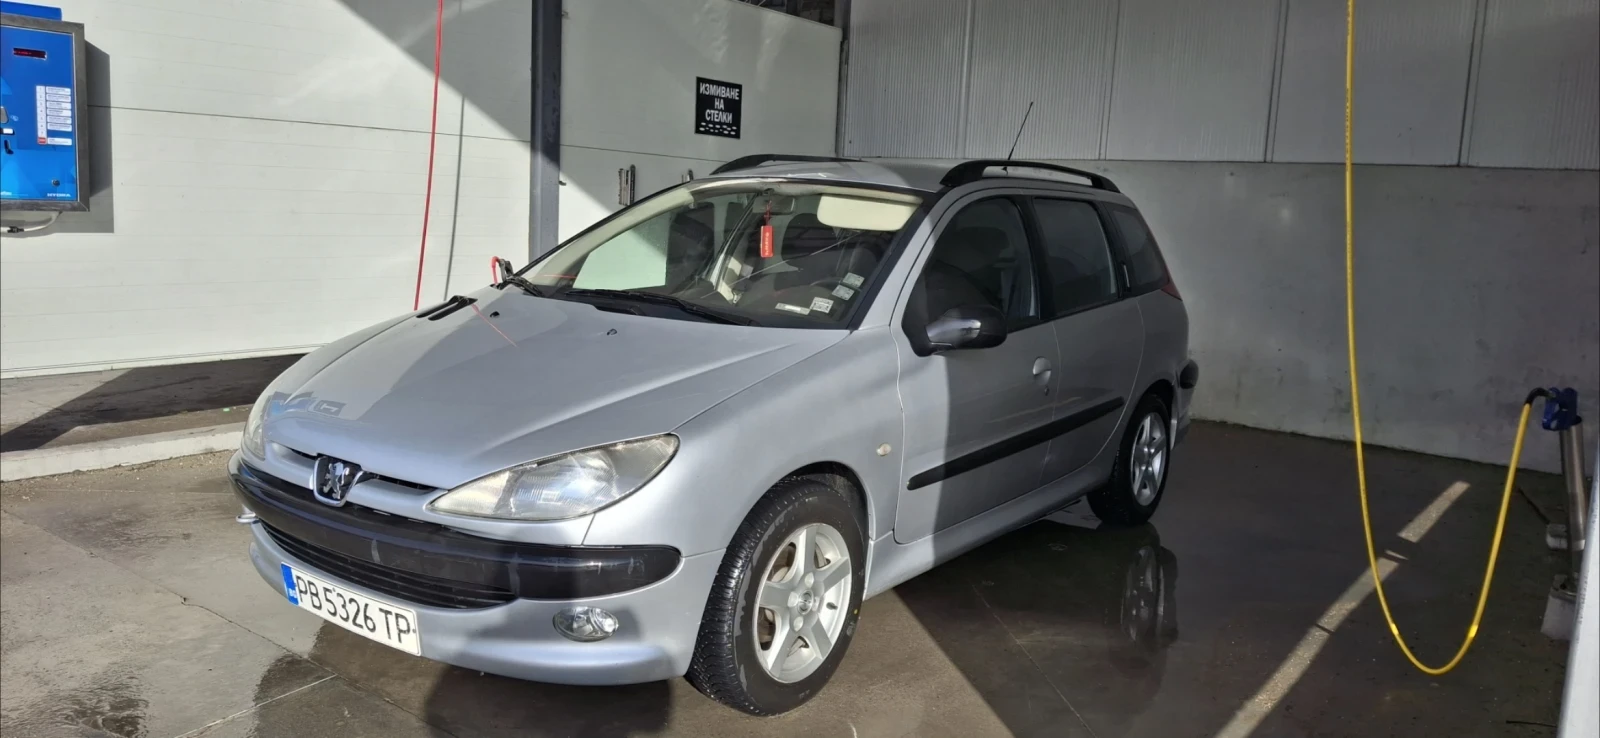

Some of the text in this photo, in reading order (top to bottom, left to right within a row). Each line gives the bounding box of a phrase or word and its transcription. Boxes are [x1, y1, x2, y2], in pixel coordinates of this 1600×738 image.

[700, 82, 739, 100] ИЗМИВАНЕ
[715, 98, 724, 110] НА
[705, 109, 732, 123] СТЕЛКИ
[323, 587, 376, 633] 5326
[378, 607, 411, 643] TP
